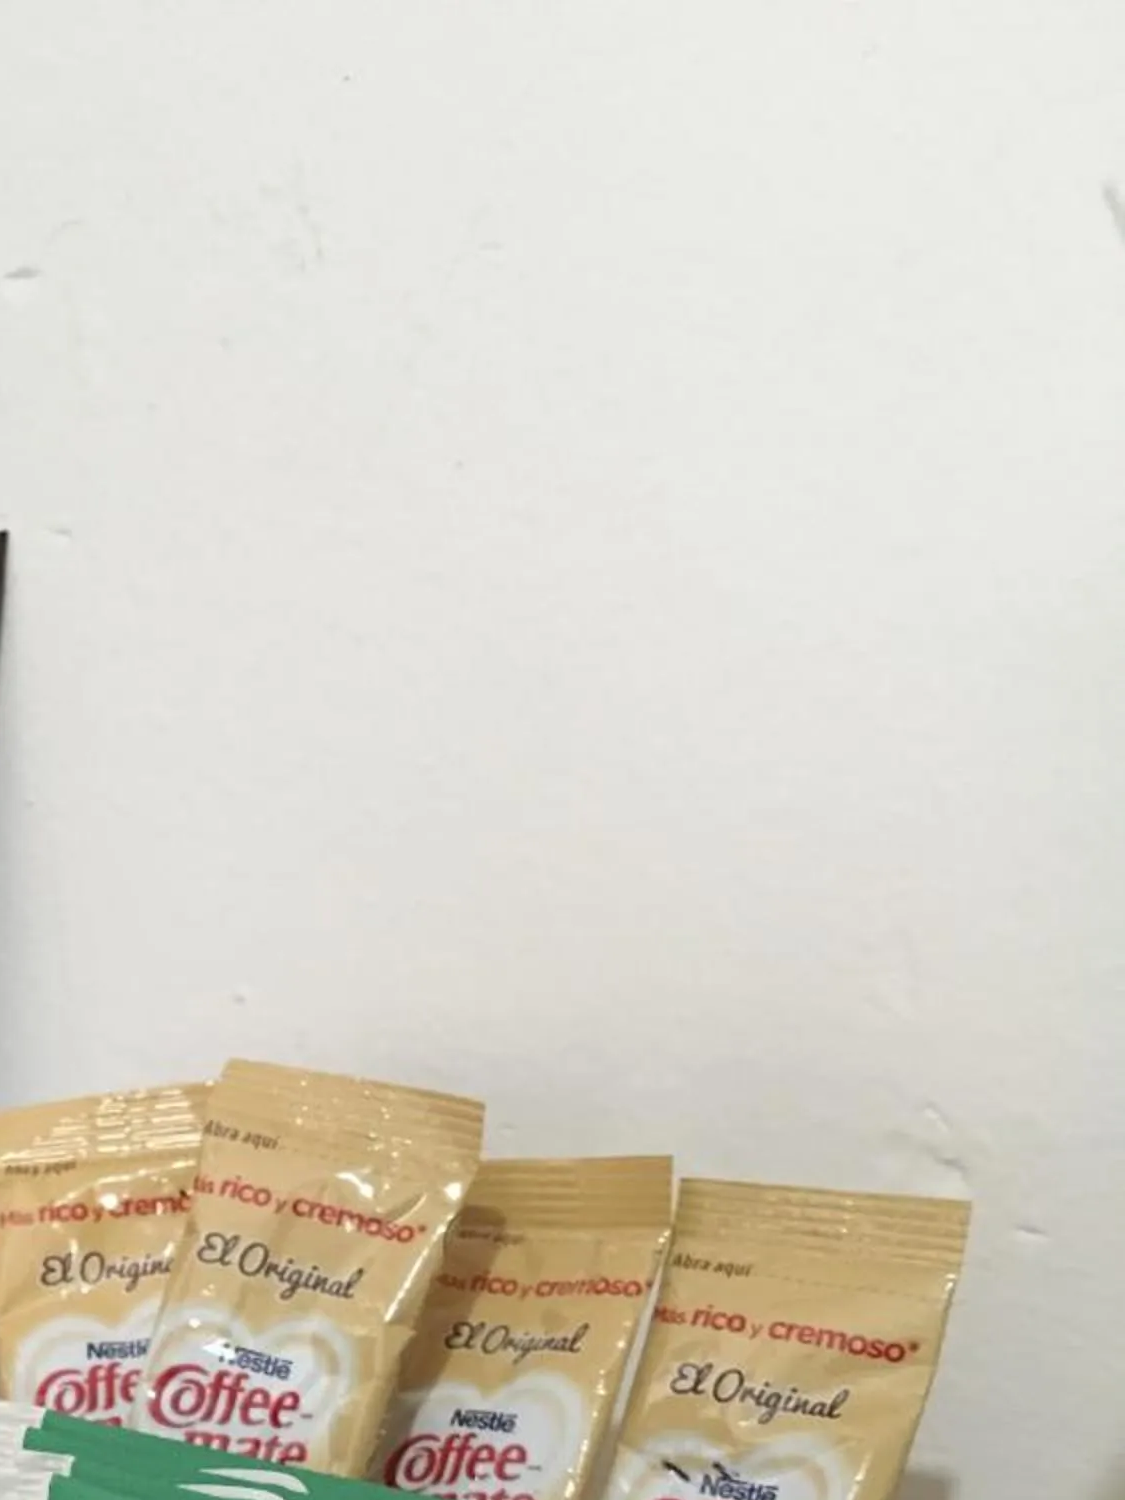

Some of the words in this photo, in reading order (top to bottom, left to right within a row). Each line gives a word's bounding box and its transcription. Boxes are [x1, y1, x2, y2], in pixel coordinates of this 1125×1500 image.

[39, 1200, 89, 1224] rico
[219, 1174, 273, 1207] rico
[275, 1197, 287, 1214] y
[40, 1253, 74, 1287] El
[196, 1230, 241, 1267] El
[237, 1241, 365, 1301] Original
[689, 1304, 747, 1333] rico
[749, 1321, 764, 1340] y
[444, 1320, 487, 1351] El
[481, 1321, 591, 1366] Original
[669, 1362, 713, 1395] El
[712, 1368, 850, 1425] Original
